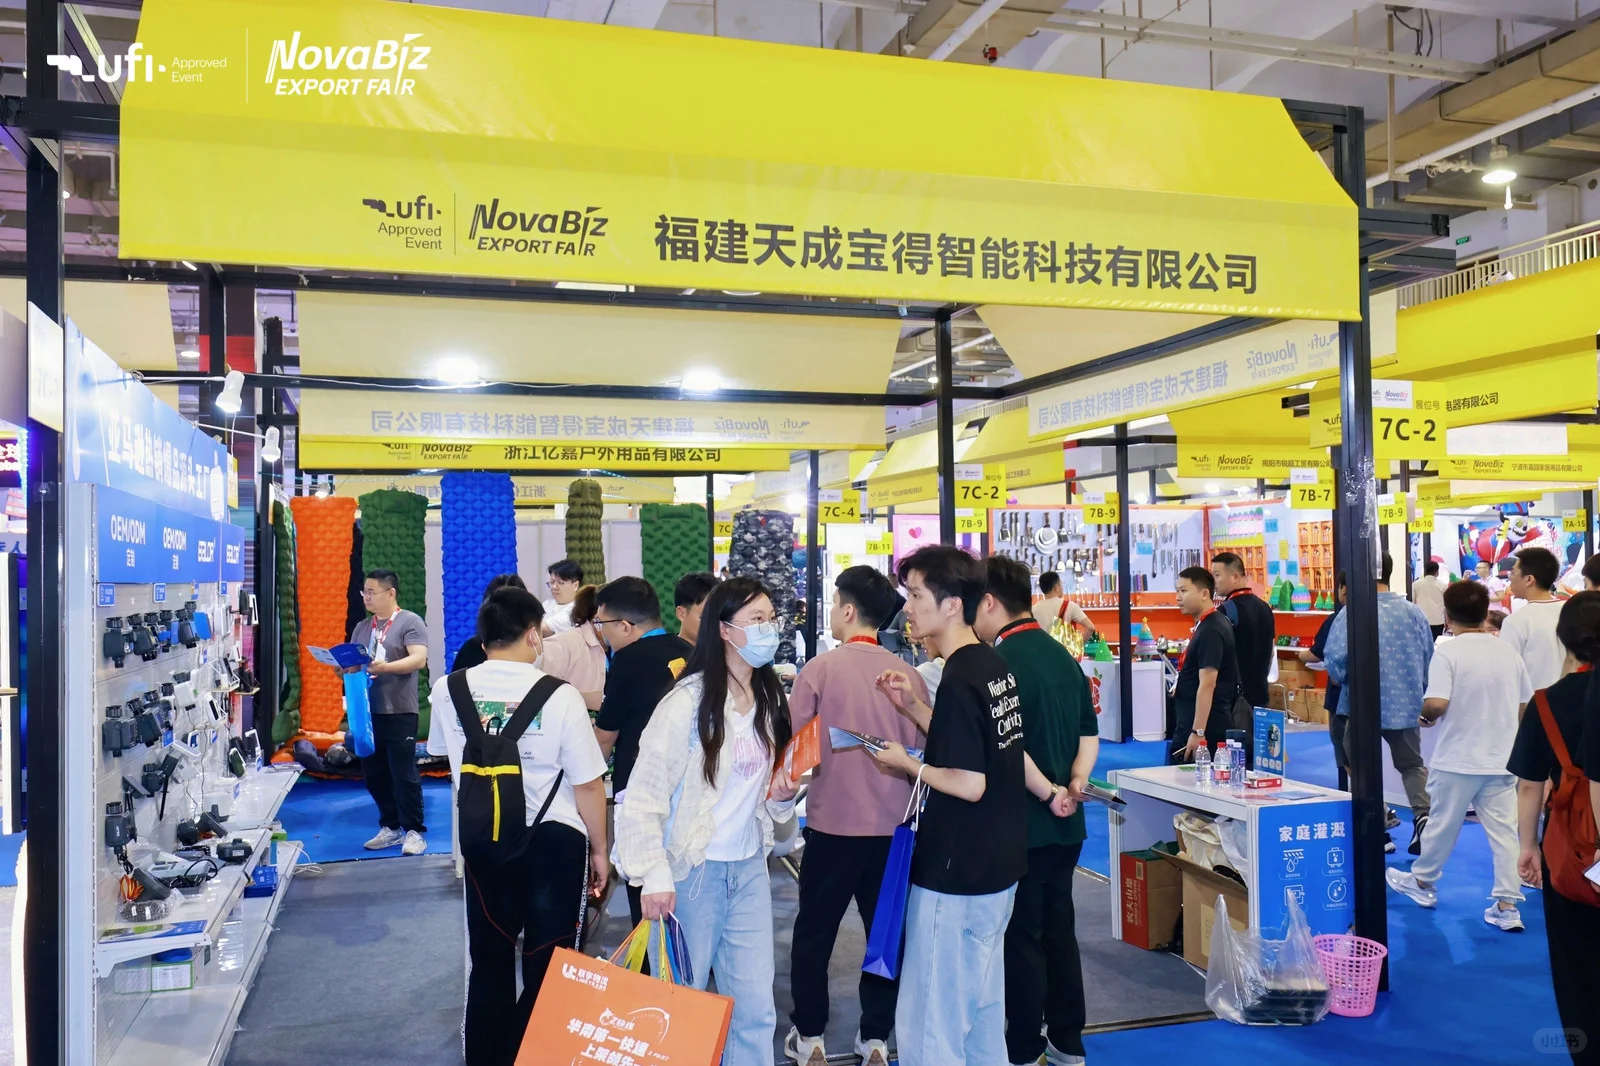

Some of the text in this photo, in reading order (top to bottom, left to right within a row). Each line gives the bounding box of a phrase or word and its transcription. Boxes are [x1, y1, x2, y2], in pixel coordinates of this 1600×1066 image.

[469, 198, 609, 240] NovaBiz
[378, 222, 442, 238] Approved
[405, 237, 442, 250] Event
[477, 236, 596, 257] EXPORT FAIR
[654, 213, 1257, 295] 福建天成宝得智能科技有限公司
[1416, 400, 1440, 411] 展位号
[1380, 418, 1436, 441] 7C-2
[1217, 454, 1253, 467] NovaBiz
[1473, 460, 1504, 469] NovaBiz
[962, 486, 999, 499] 7C-2
[1299, 489, 1331, 501] 7B-7
[824, 506, 855, 517] 7C-4
[1090, 508, 1115, 517] 7B-9
[1383, 508, 1403, 518] 7B-9
[111, 514, 146, 545] OEM/ODM
[960, 519, 982, 528] 7B-9
[1565, 519, 1586, 528] 7A-15
[1279, 821, 1346, 842] 家庭灌溉
